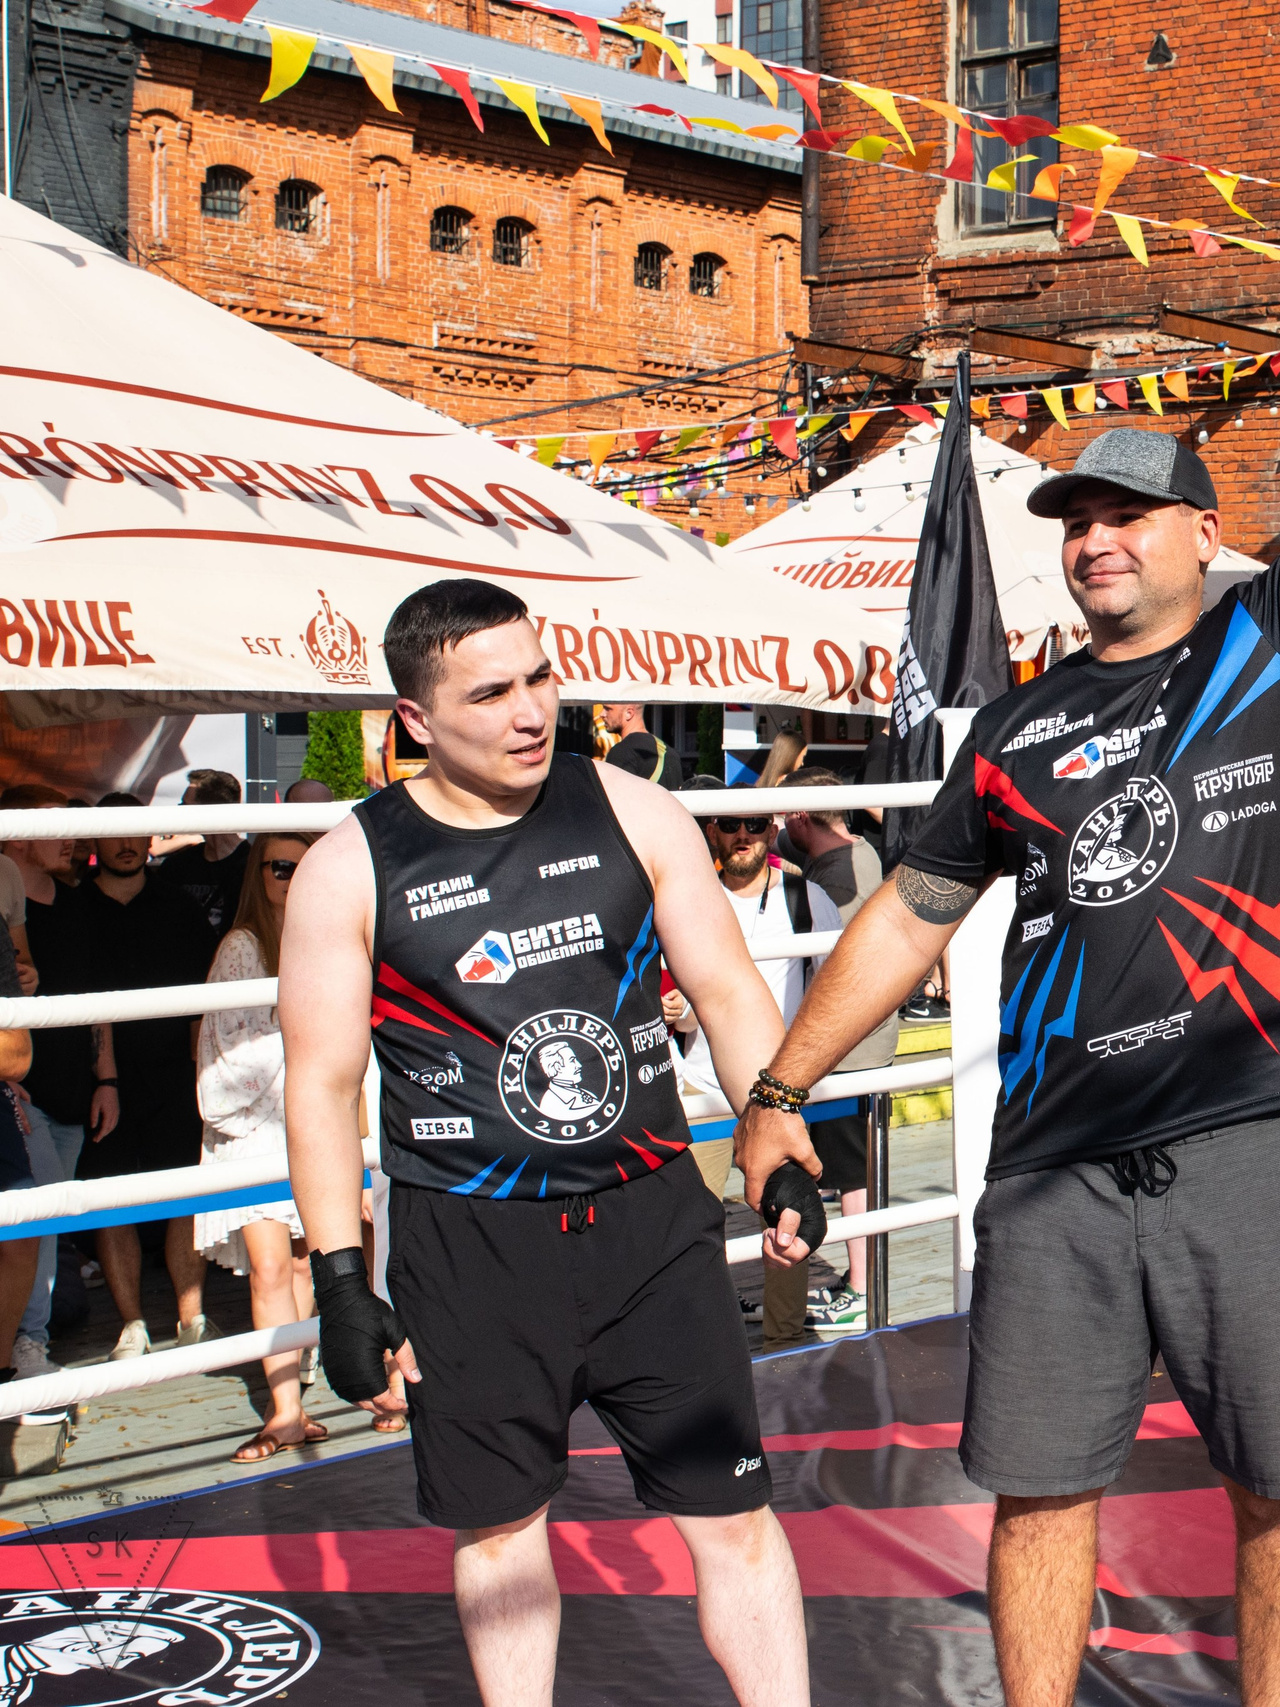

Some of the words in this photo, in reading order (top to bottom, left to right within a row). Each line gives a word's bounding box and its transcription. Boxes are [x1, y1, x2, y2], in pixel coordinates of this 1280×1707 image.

[241, 636, 296, 659] EST.
[1018, 711, 1067, 736] ДРЕЙ
[1194, 761, 1275, 802] КРУТОЯР
[1231, 800, 1277, 822] LADOGA
[538, 854, 601, 880] FARFOR
[1073, 860, 1158, 899] 2010
[404, 874, 475, 904] ХУСАИН
[409, 887, 491, 922] ГАЙИБОВ
[509, 912, 604, 955] БИТВА
[503, 1014, 623, 1095] КАНЦЛЕРЪ
[415, 1122, 469, 1136] SIBSA
[534, 1102, 617, 1137] 2010
